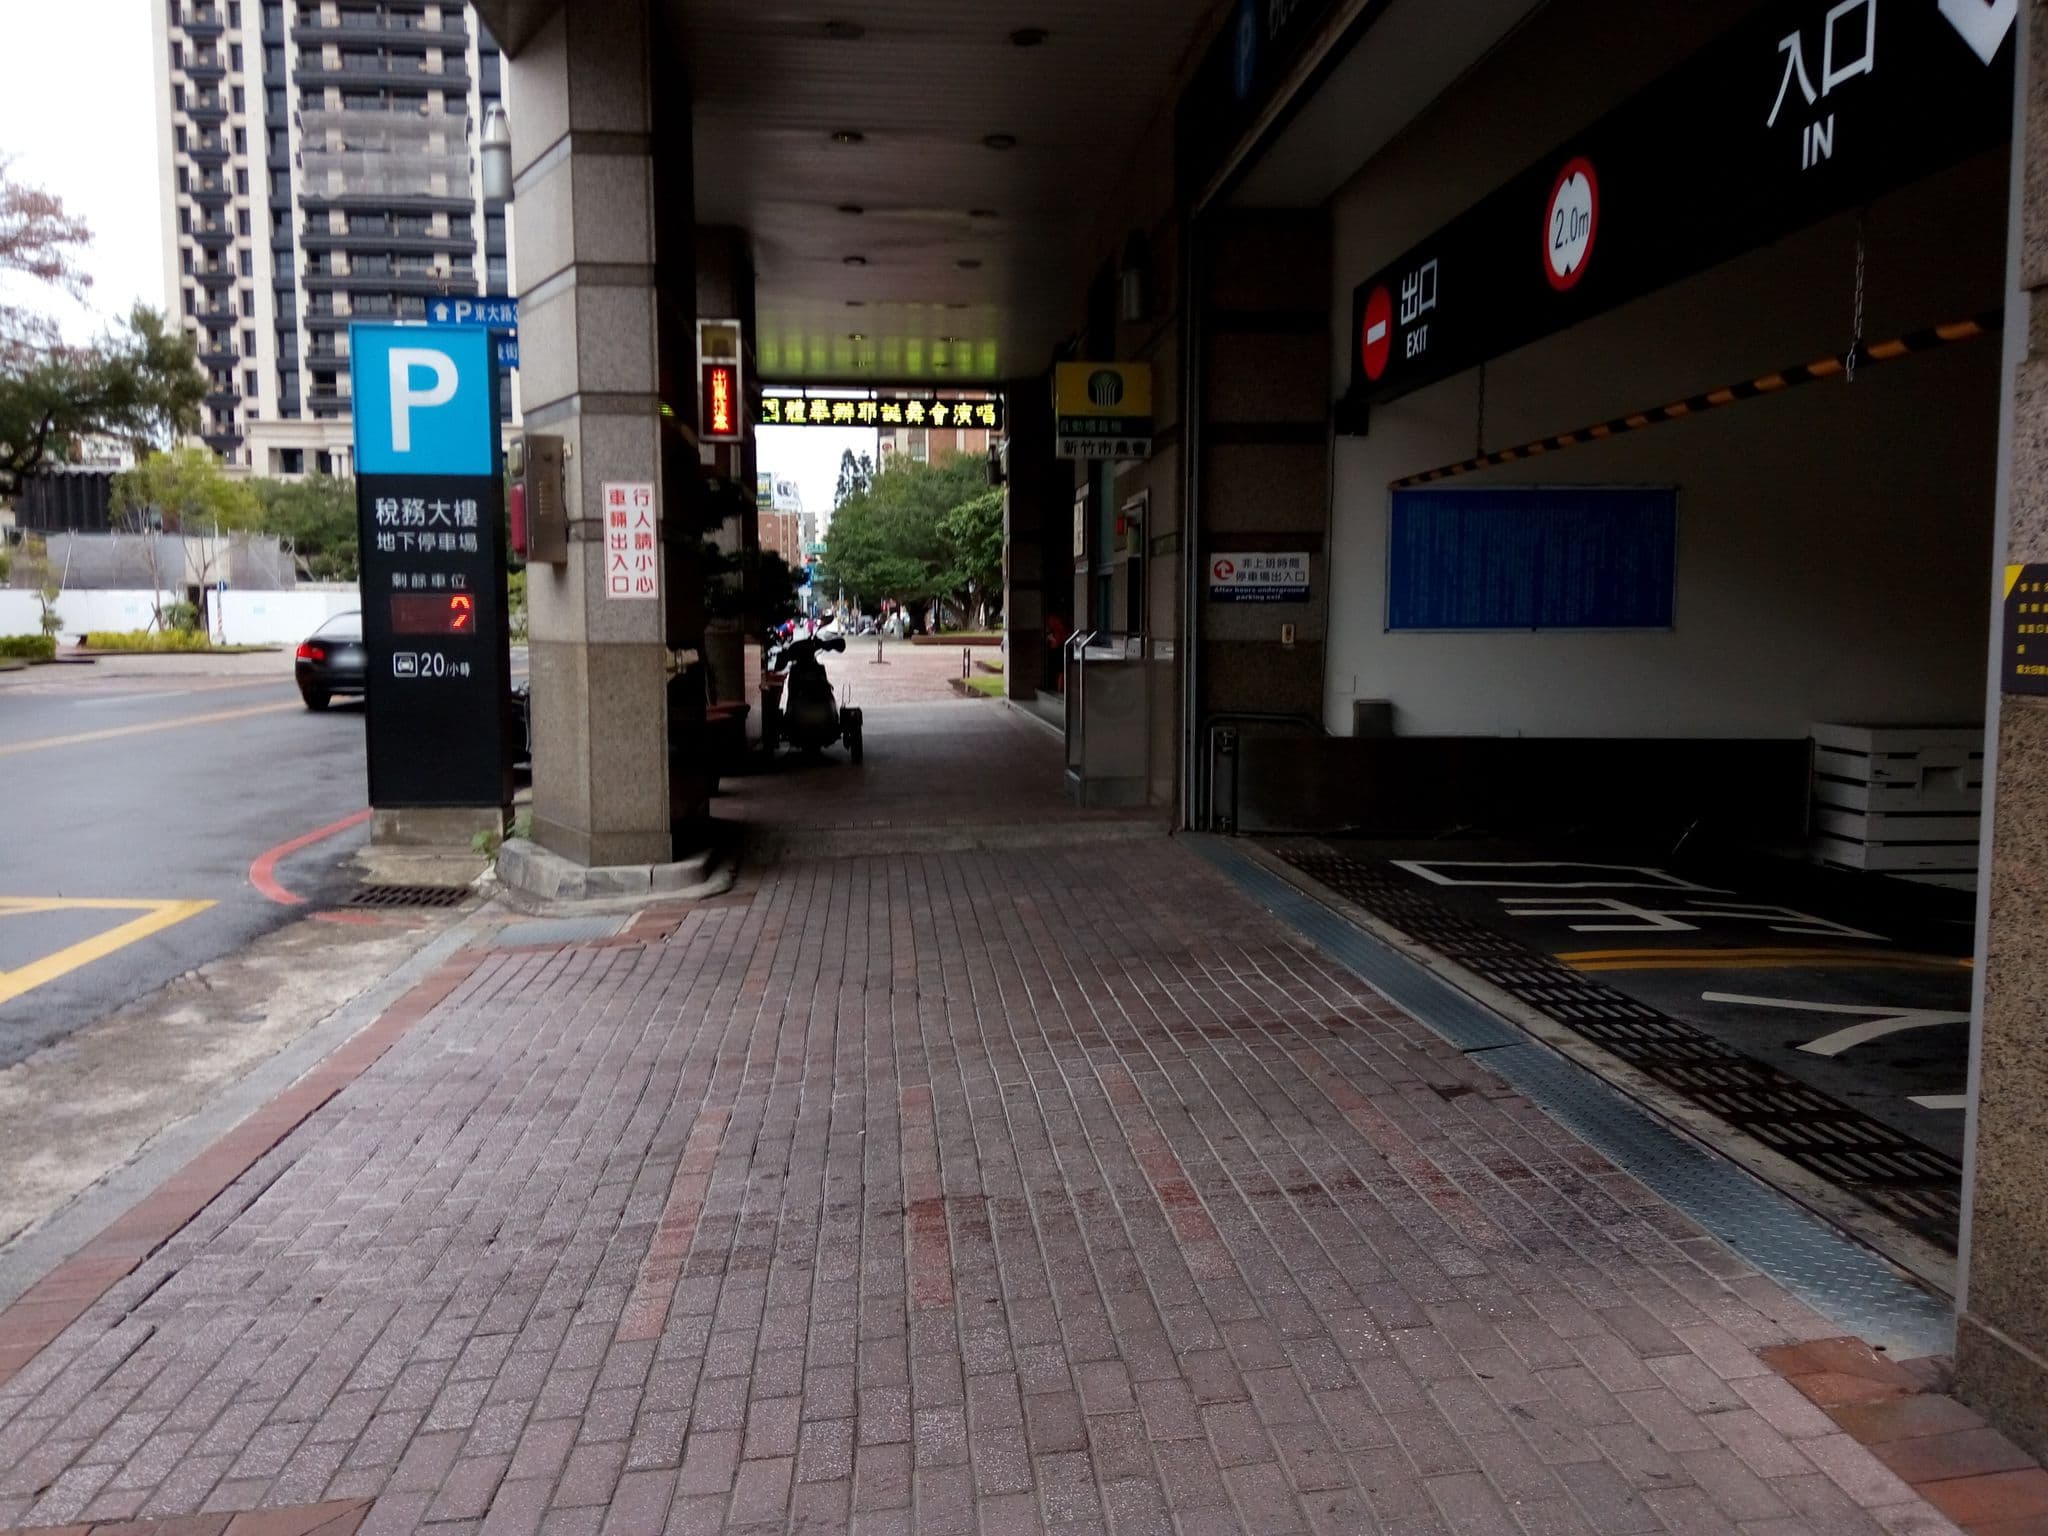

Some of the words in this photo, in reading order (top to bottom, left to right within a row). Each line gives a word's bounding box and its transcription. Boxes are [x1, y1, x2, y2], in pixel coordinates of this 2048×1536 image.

[1766, 0, 1877, 128] 入口
[1802, 113, 1834, 170] IN
[1554, 206, 1589, 250] 2.0m
[455, 300, 472, 325] P
[1401, 258, 1438, 326] 出口
[1406, 324, 1429, 359] EXIT
[388, 347, 459, 453] P
[375, 497, 478, 527] 稅務大樓
[609, 488, 629, 593] 車輛出入口
[633, 488, 653, 593] 行人請小心
[377, 531, 478, 553] 地下停車場
